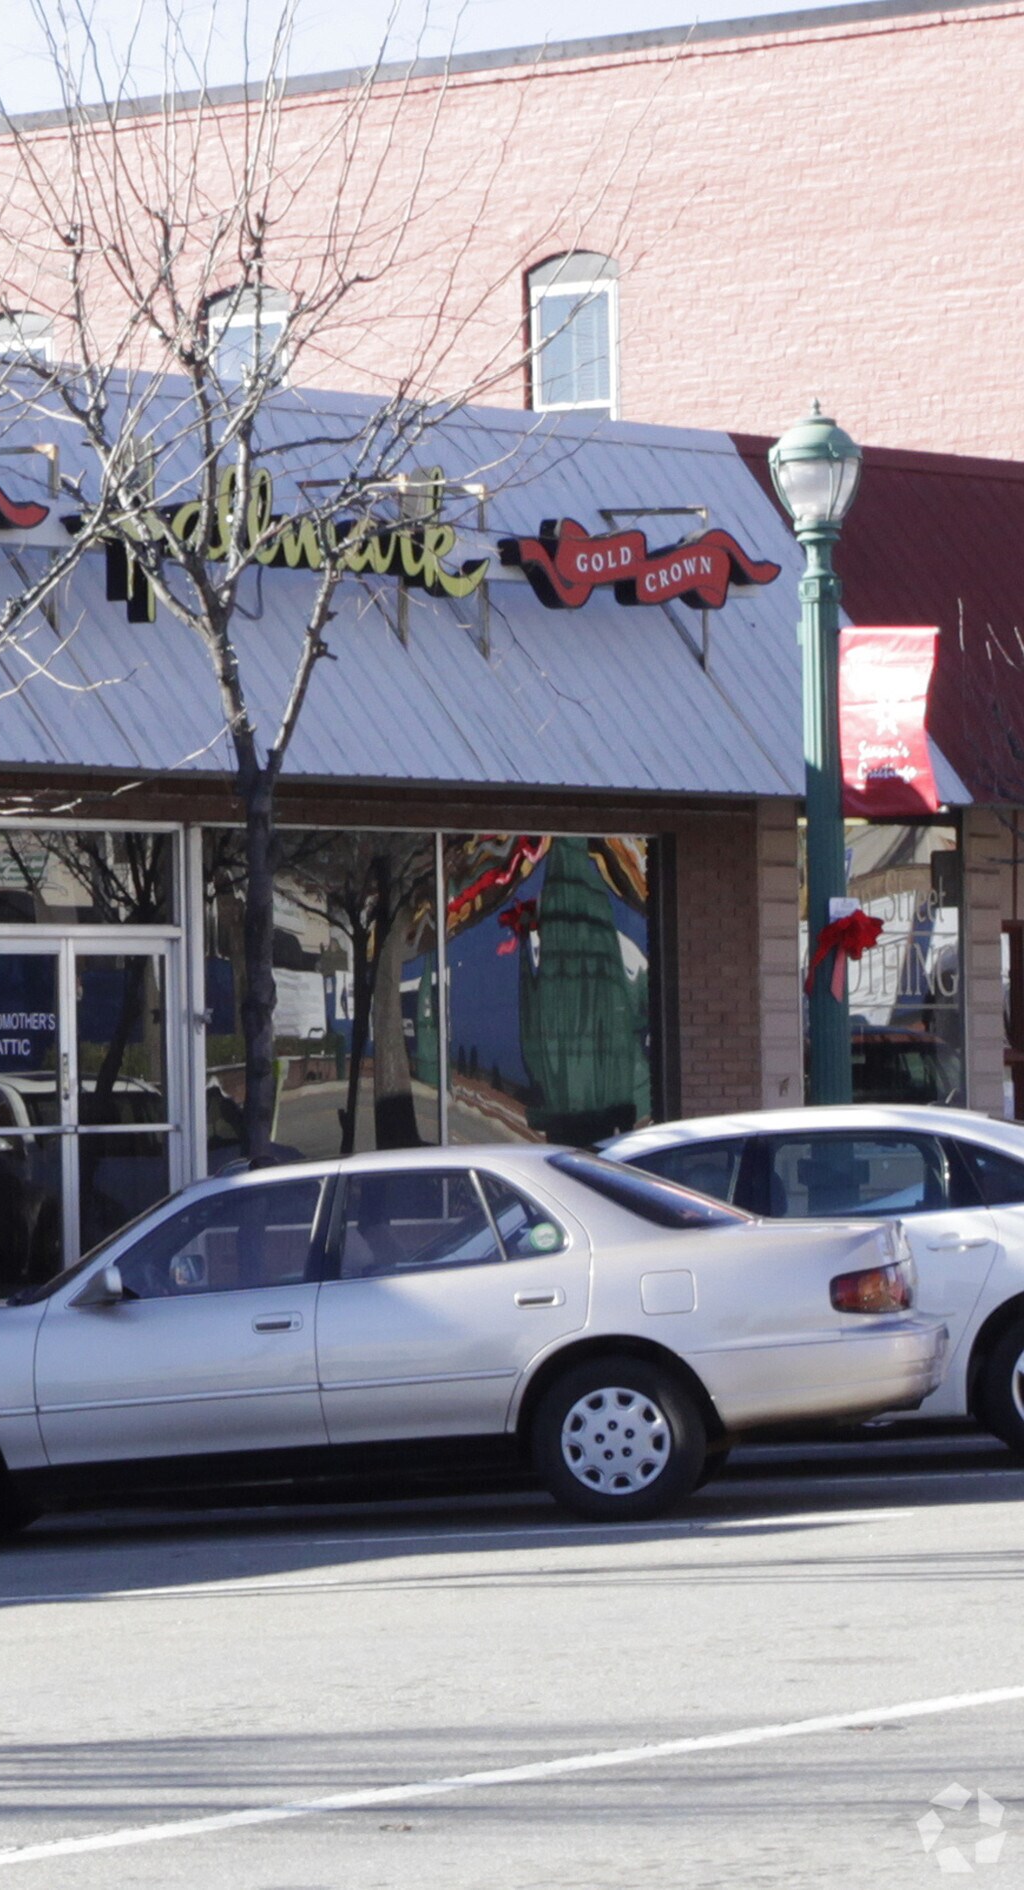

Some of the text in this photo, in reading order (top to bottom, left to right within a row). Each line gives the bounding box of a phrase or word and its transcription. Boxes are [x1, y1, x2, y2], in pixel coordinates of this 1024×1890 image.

[78, 434, 490, 622] Hallmark
[576, 546, 632, 572] GOLD
[645, 555, 713, 593] CROWN
[884, 869, 946, 922] Street
